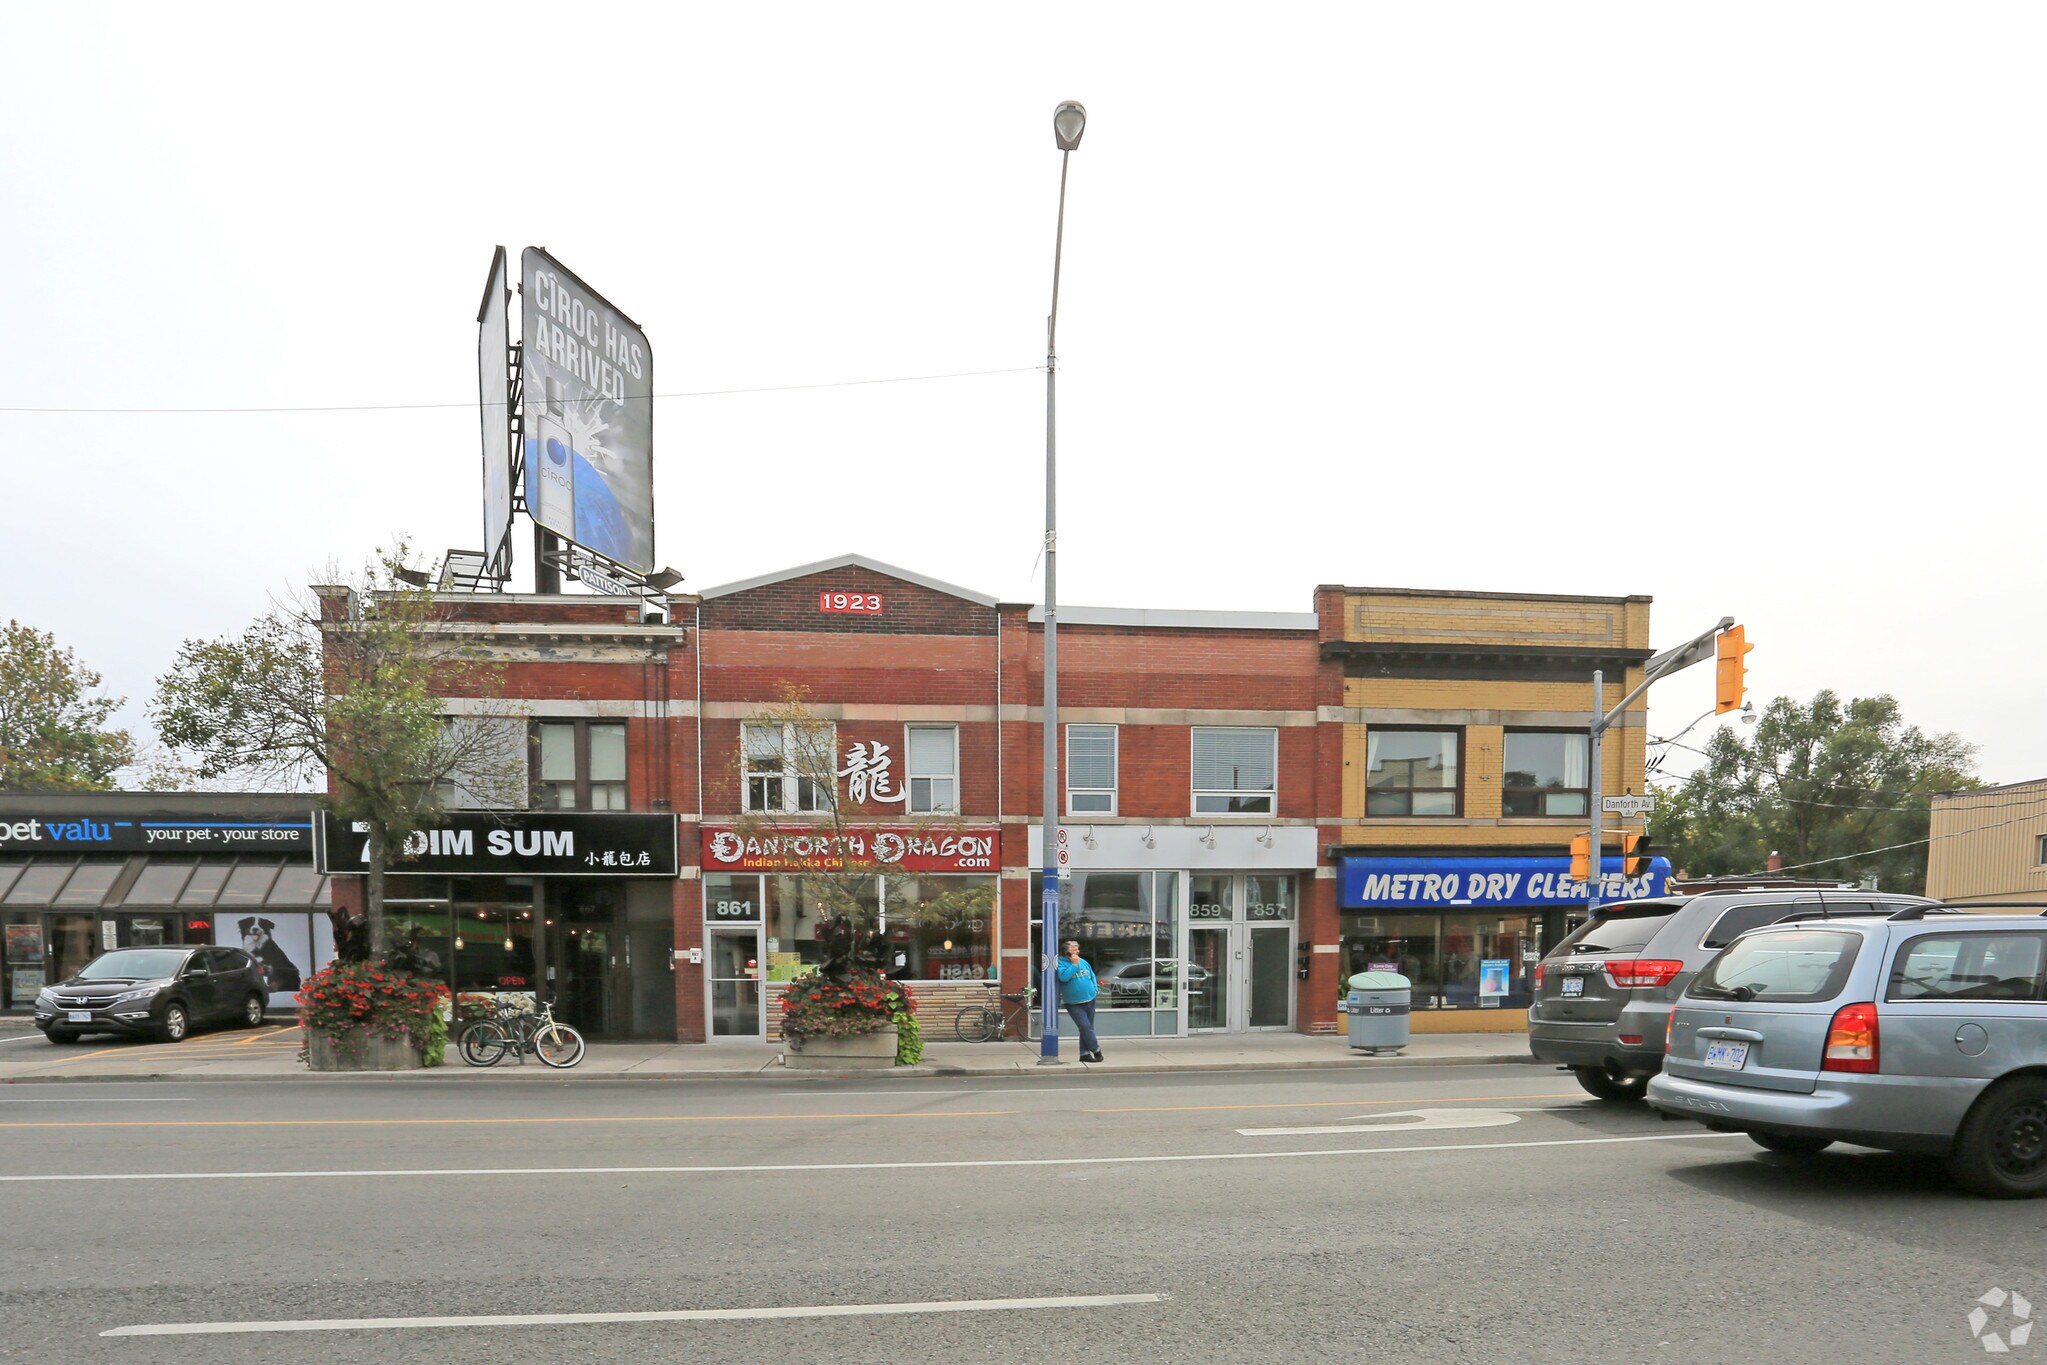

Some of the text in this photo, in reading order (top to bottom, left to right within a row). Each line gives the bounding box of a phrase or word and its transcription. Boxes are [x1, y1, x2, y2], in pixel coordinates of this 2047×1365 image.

[535, 269, 642, 380] CÎROC HAS
[535, 314, 625, 406] ARRIVED
[583, 569, 627, 595] PATTISON
[823, 593, 881, 611] 1923
[837, 740, 906, 805] 龍
[1605, 799, 1639, 809] Danforth
[0, 818, 112, 847] pet valu
[146, 828, 299, 843] your pet your store
[403, 830, 473, 856] DIM
[487, 830, 575, 857] SUM
[709, 831, 992, 864] DANFORTH DRAGON
[584, 851, 651, 866] 小籠包店
[743, 857, 781, 868] Indian
[824, 857, 871, 868] Chiese
[1362, 873, 1460, 902] METRO
[1467, 873, 1521, 901] DRY
[716, 900, 751, 915] 861
[1189, 904, 1222, 917] 859
[1254, 903, 1287, 916] 857
[188, 920, 211, 929] OPEN
[497, 975, 527, 985] OPEN
[1101, 981, 1151, 996] SALON
